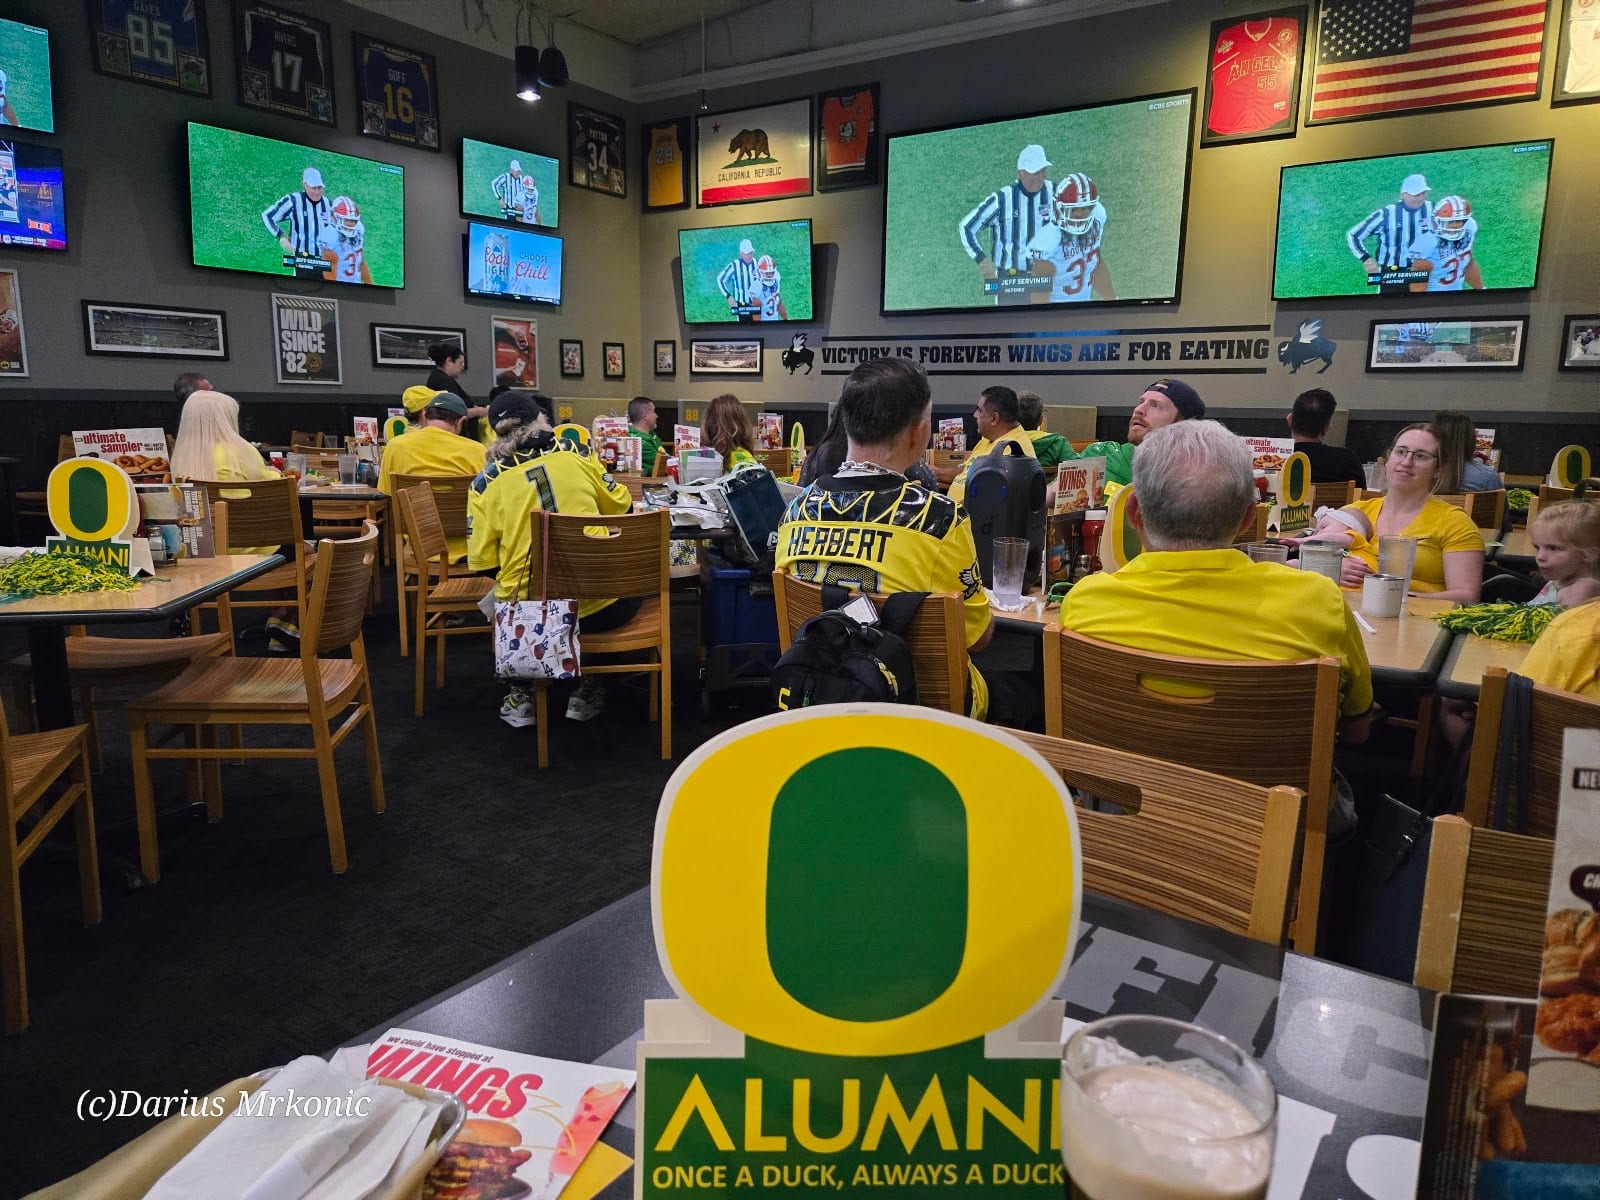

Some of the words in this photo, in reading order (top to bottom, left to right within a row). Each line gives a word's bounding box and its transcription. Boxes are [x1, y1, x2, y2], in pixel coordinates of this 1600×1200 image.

[127, 13, 175, 65] 85
[271, 49, 304, 94] 17
[387, 68, 407, 84] GOFF
[1226, 55, 1282, 86] ANGELS
[1257, 74, 1277, 92] 55
[383, 82, 416, 124] 16
[587, 142, 609, 176] 34
[656, 146, 673, 165] 24
[717, 170, 751, 183] CALIFORNIA
[754, 166, 782, 178] REPUBLIC
[520, 251, 549, 263] CHOOSE
[515, 261, 550, 280] Chill
[1001, 278, 1017, 287] JEFF
[1017, 276, 1051, 286] SERVINSKI
[279, 308, 322, 332] WILD
[281, 329, 326, 354] SINCE
[822, 346, 891, 364] VICTORY
[918, 345, 1001, 364] FOREVER
[1007, 343, 1073, 363] WINGS
[1078, 342, 1120, 362] ARE
[1127, 341, 1171, 361] FOR
[1179, 338, 1270, 361] EATING
[282, 351, 308, 373] '82
[83, 431, 127, 445] ultimate
[100, 441, 143, 455] sampler
[1253, 445, 1280, 455] sampler
[1058, 469, 1088, 492] WINGS
[1281, 508, 1310, 522] ALUMNI
[787, 526, 893, 564] HERBERT
[386, 1035, 401, 1044] we
[400, 1036, 425, 1049] could
[425, 1041, 447, 1053] have
[446, 1046, 481, 1061] stopped
[481, 1054, 494, 1063] at
[366, 1043, 544, 1119] WINGS
[654, 1072, 1062, 1155] ALUMNI
[652, 1164, 728, 1189] ONCE
[734, 1164, 755, 1188] A
[762, 1163, 845, 1190] DUCK,
[851, 1163, 959, 1187] ALWAYS
[964, 1163, 985, 1186] A
[992, 1162, 1065, 1186] DUCK
